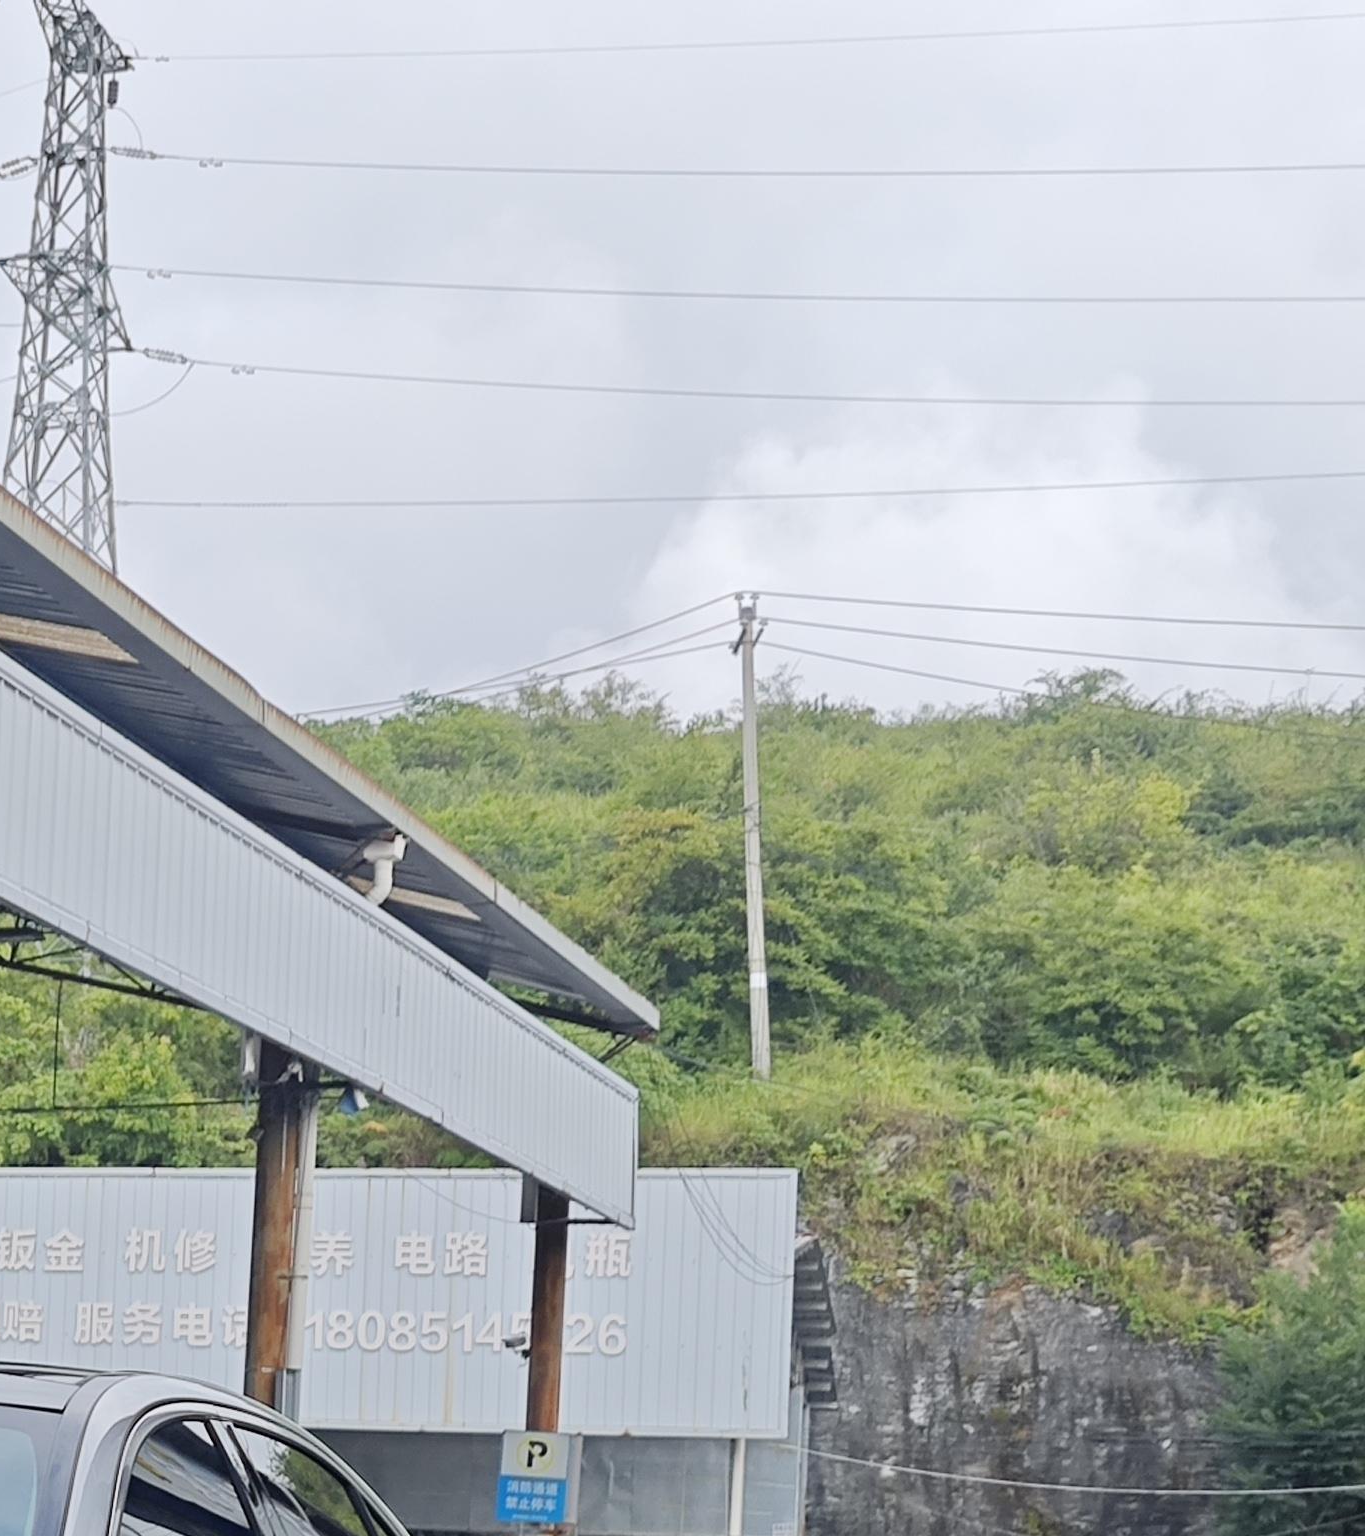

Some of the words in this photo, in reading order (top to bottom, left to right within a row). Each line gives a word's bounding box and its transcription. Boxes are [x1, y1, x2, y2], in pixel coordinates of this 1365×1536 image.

[123, 1227, 217, 1275] 机修
[394, 1231, 490, 1277] 电路
[304, 1310, 629, 1356] 1808514526
[526, 1440, 548, 1468] P
[504, 1496, 558, 1512] 禁止停车
